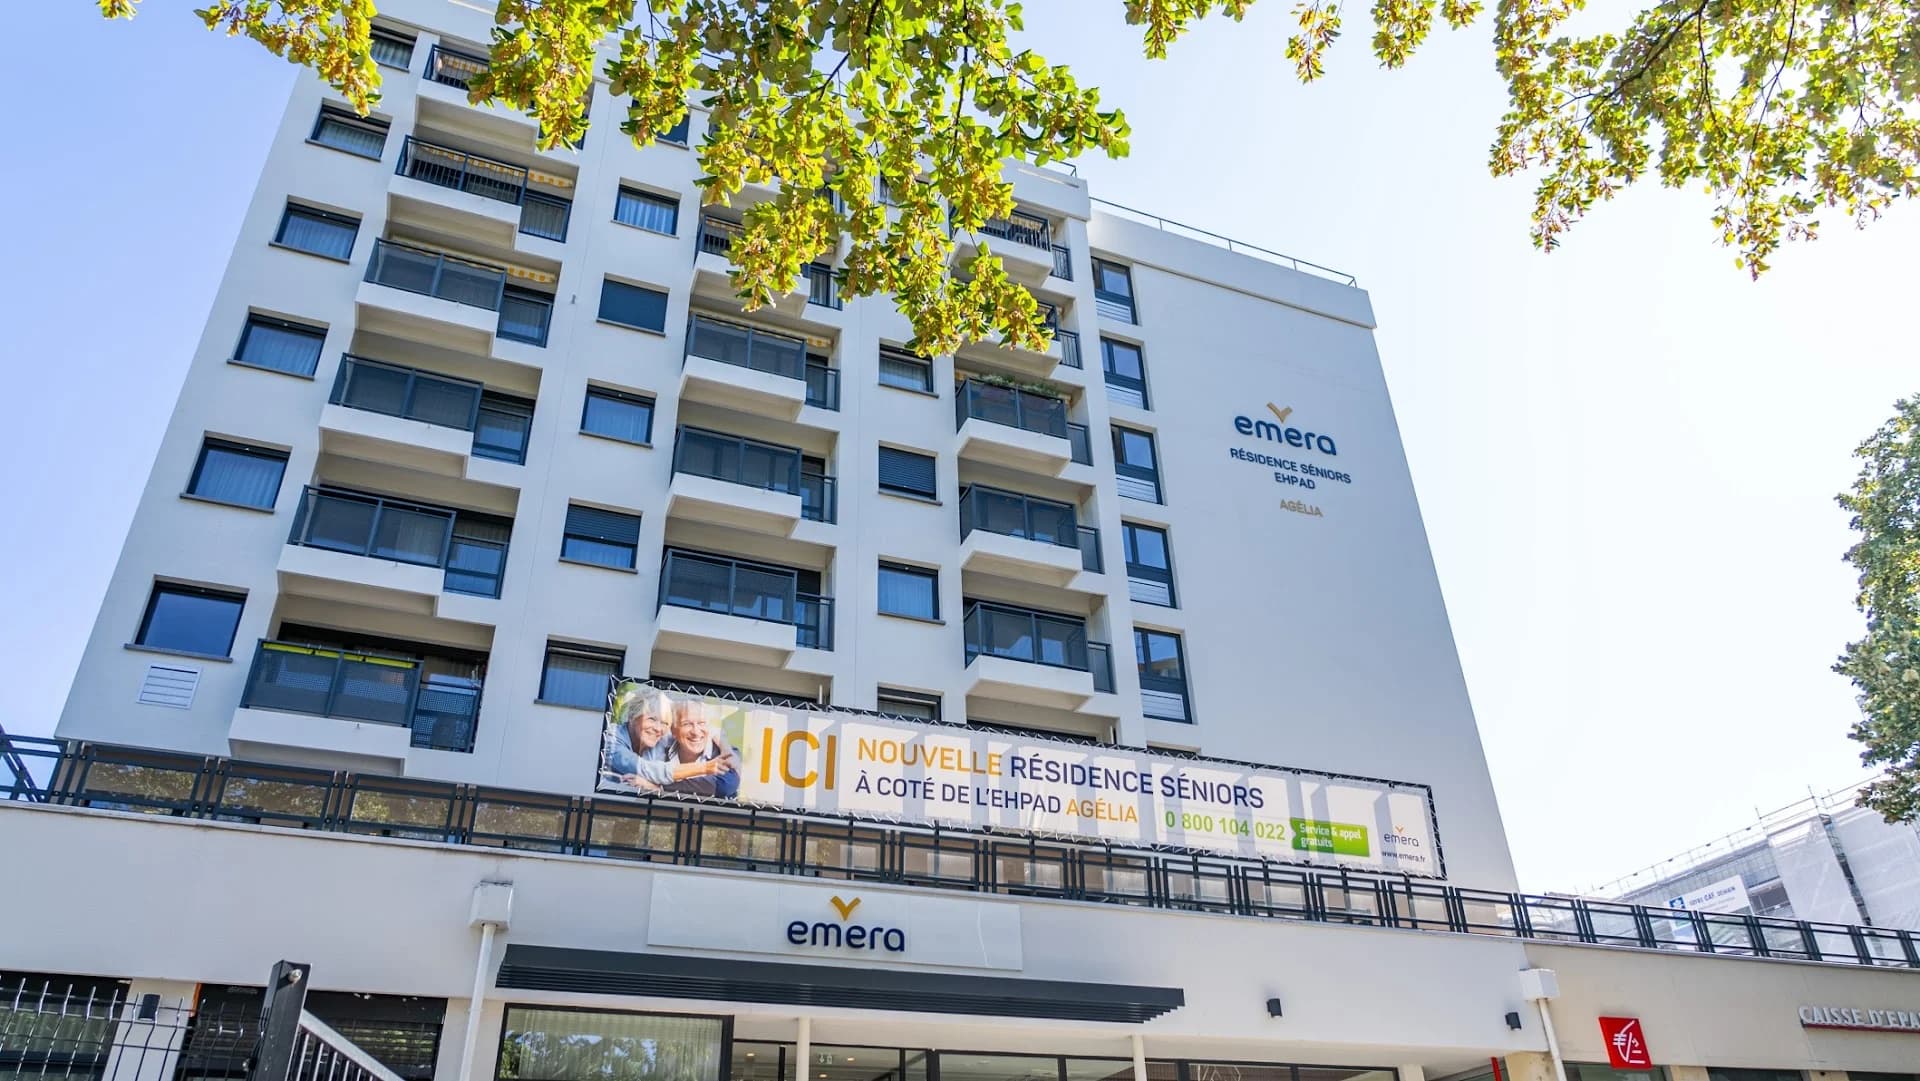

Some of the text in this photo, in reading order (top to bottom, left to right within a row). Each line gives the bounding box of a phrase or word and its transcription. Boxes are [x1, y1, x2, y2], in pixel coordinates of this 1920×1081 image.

[1234, 415, 1337, 456] emera
[1230, 447, 1352, 484] RÉSIDENCE SÉNIORS
[1274, 472, 1316, 489] EHPAD
[1280, 499, 1323, 517] AGÉLIA
[760, 728, 837, 790] ICI
[857, 737, 1264, 809] NOUVELLE RÉSIDENCE SÉNIORS
[855, 769, 1138, 823] À COTÉ DE L'EHPAD AGÉLIA
[1165, 810, 1286, 840] 0 800 104 022
[1300, 822, 1330, 837] Service
[1340, 829, 1362, 841] appel
[1301, 836, 1333, 849] gratuits
[1383, 833, 1420, 848] emera
[1381, 850, 1426, 863] www.emera.fr
[787, 920, 905, 952] emera
[1799, 1007, 1920, 1030] CAISSE D'EPA
